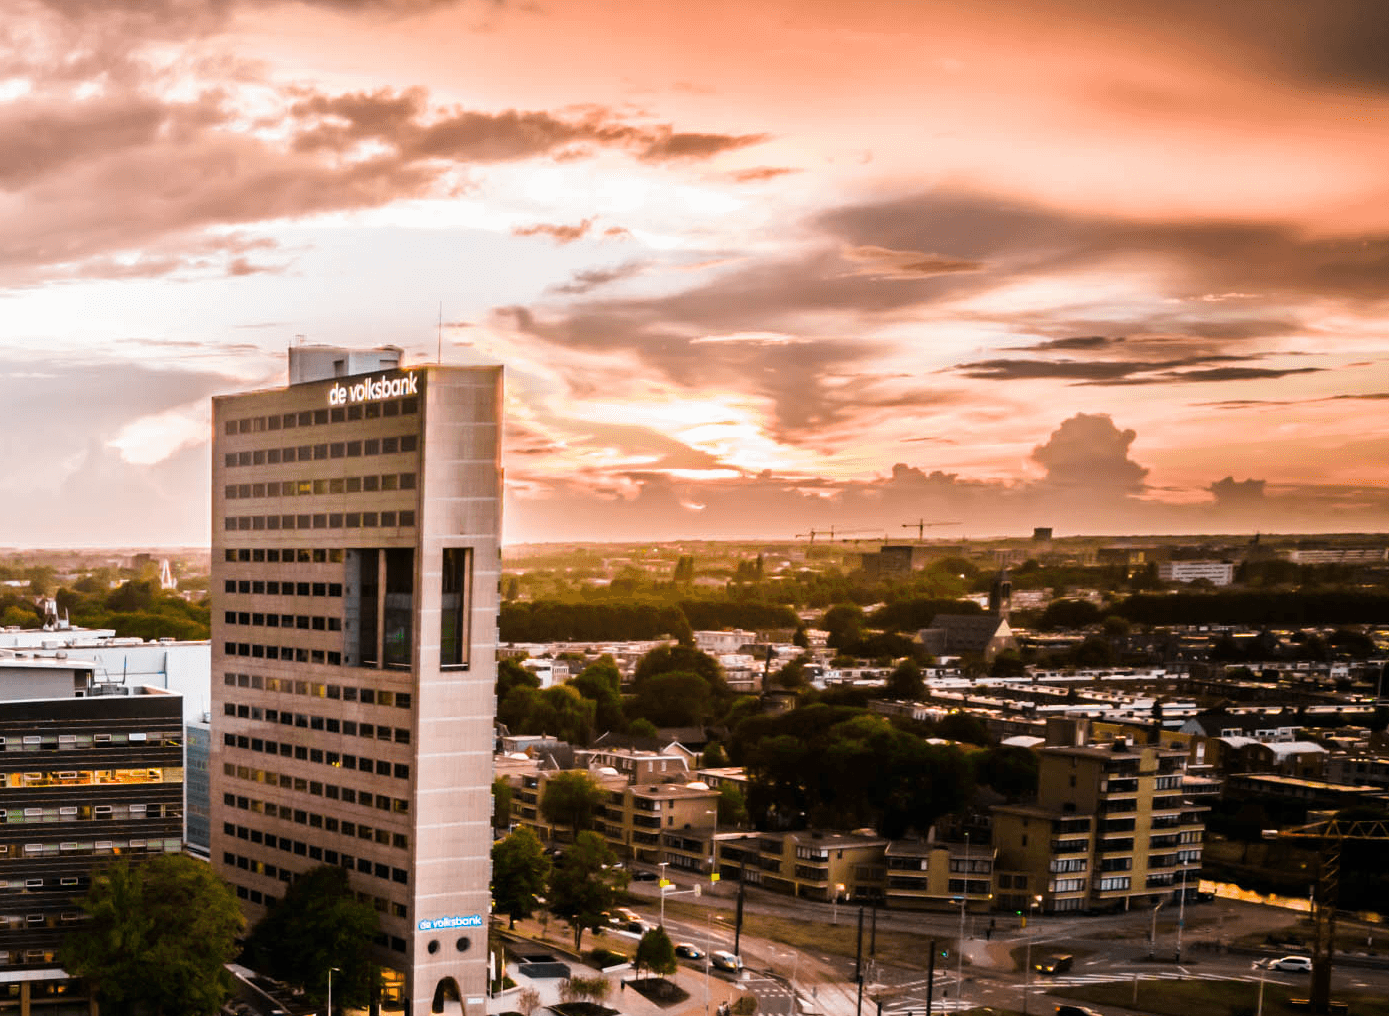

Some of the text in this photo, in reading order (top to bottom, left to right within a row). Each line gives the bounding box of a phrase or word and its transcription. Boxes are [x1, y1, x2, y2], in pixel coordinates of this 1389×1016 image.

[329, 371, 418, 405] de volksbank
[433, 915, 481, 928] volksbank
